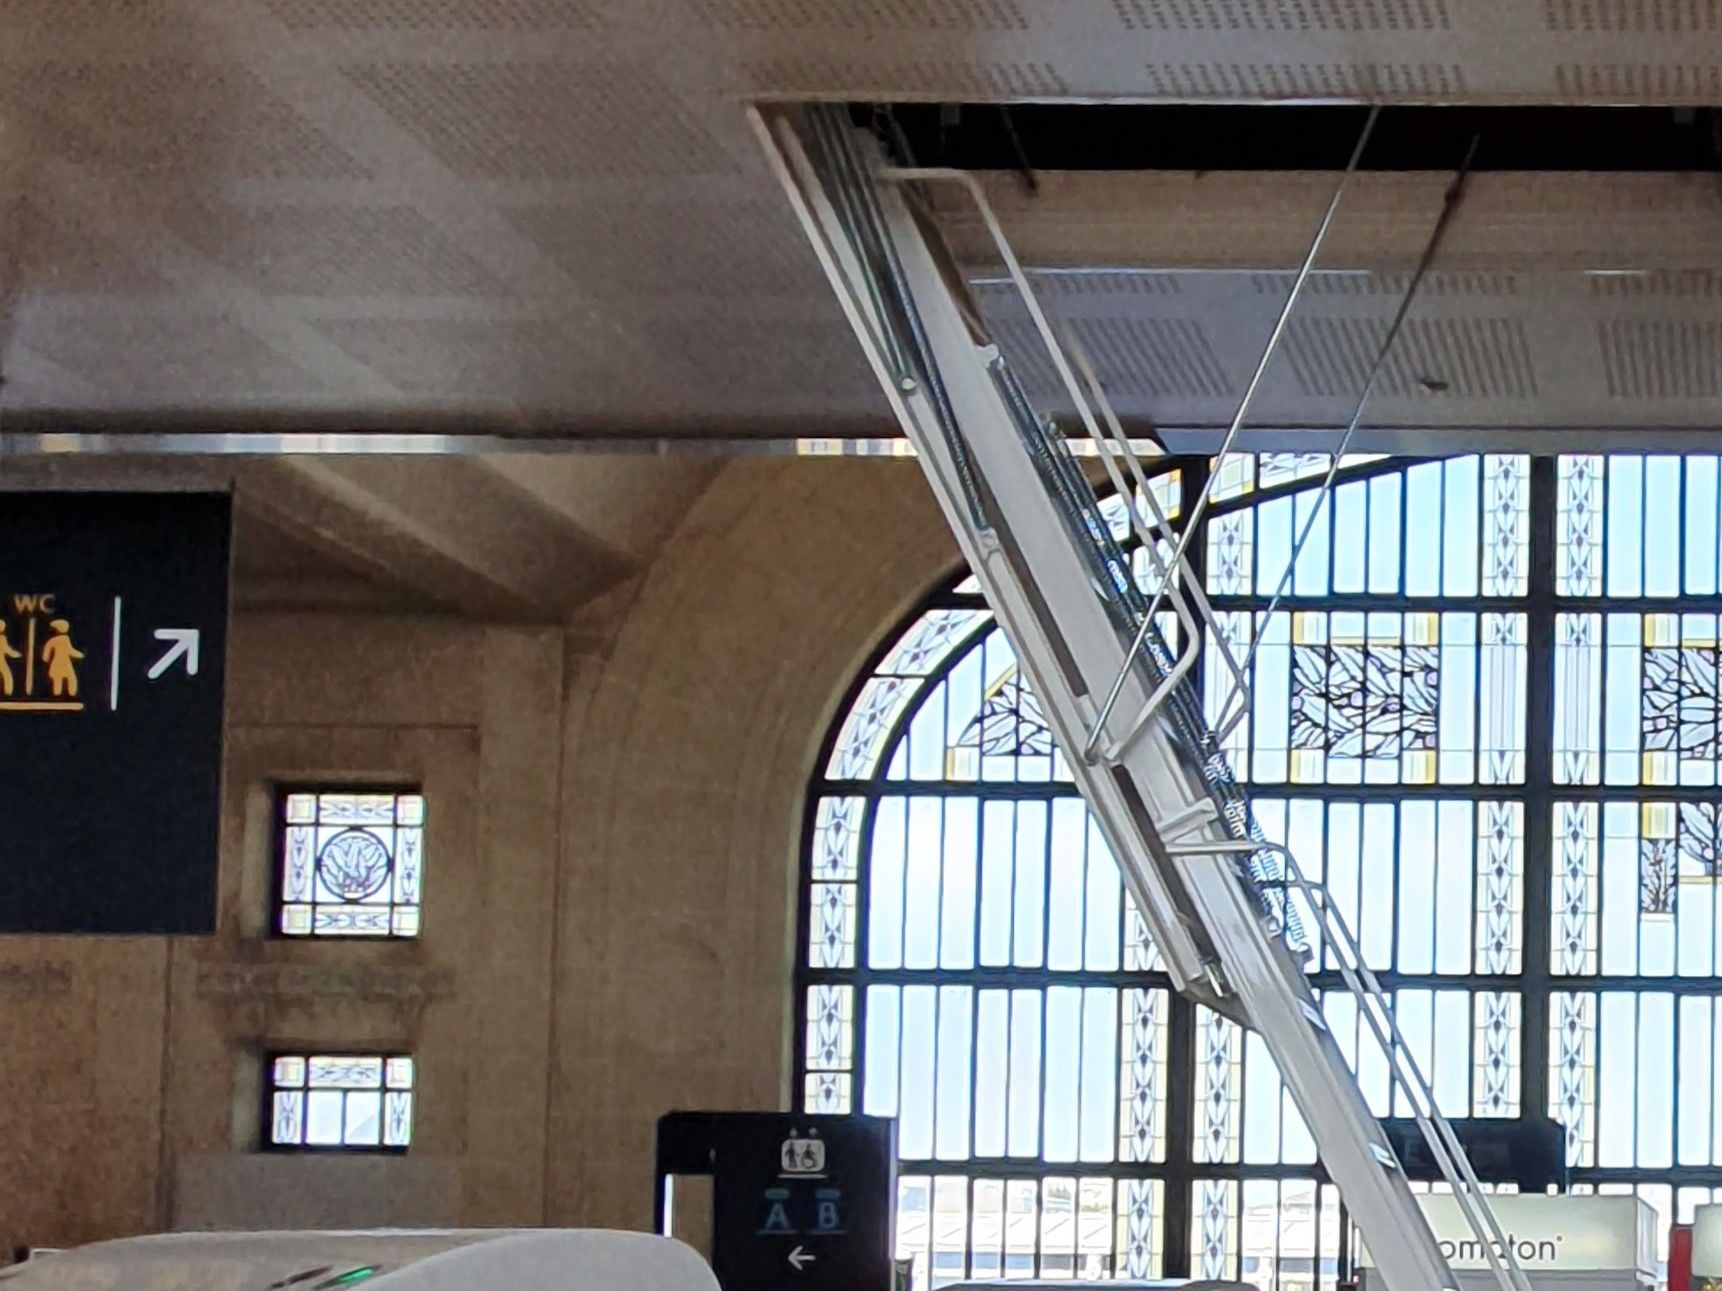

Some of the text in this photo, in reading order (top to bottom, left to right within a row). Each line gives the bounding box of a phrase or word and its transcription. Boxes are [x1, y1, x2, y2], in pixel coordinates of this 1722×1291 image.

[14, 593, 56, 615] WC
[765, 1201, 838, 1230] A B
